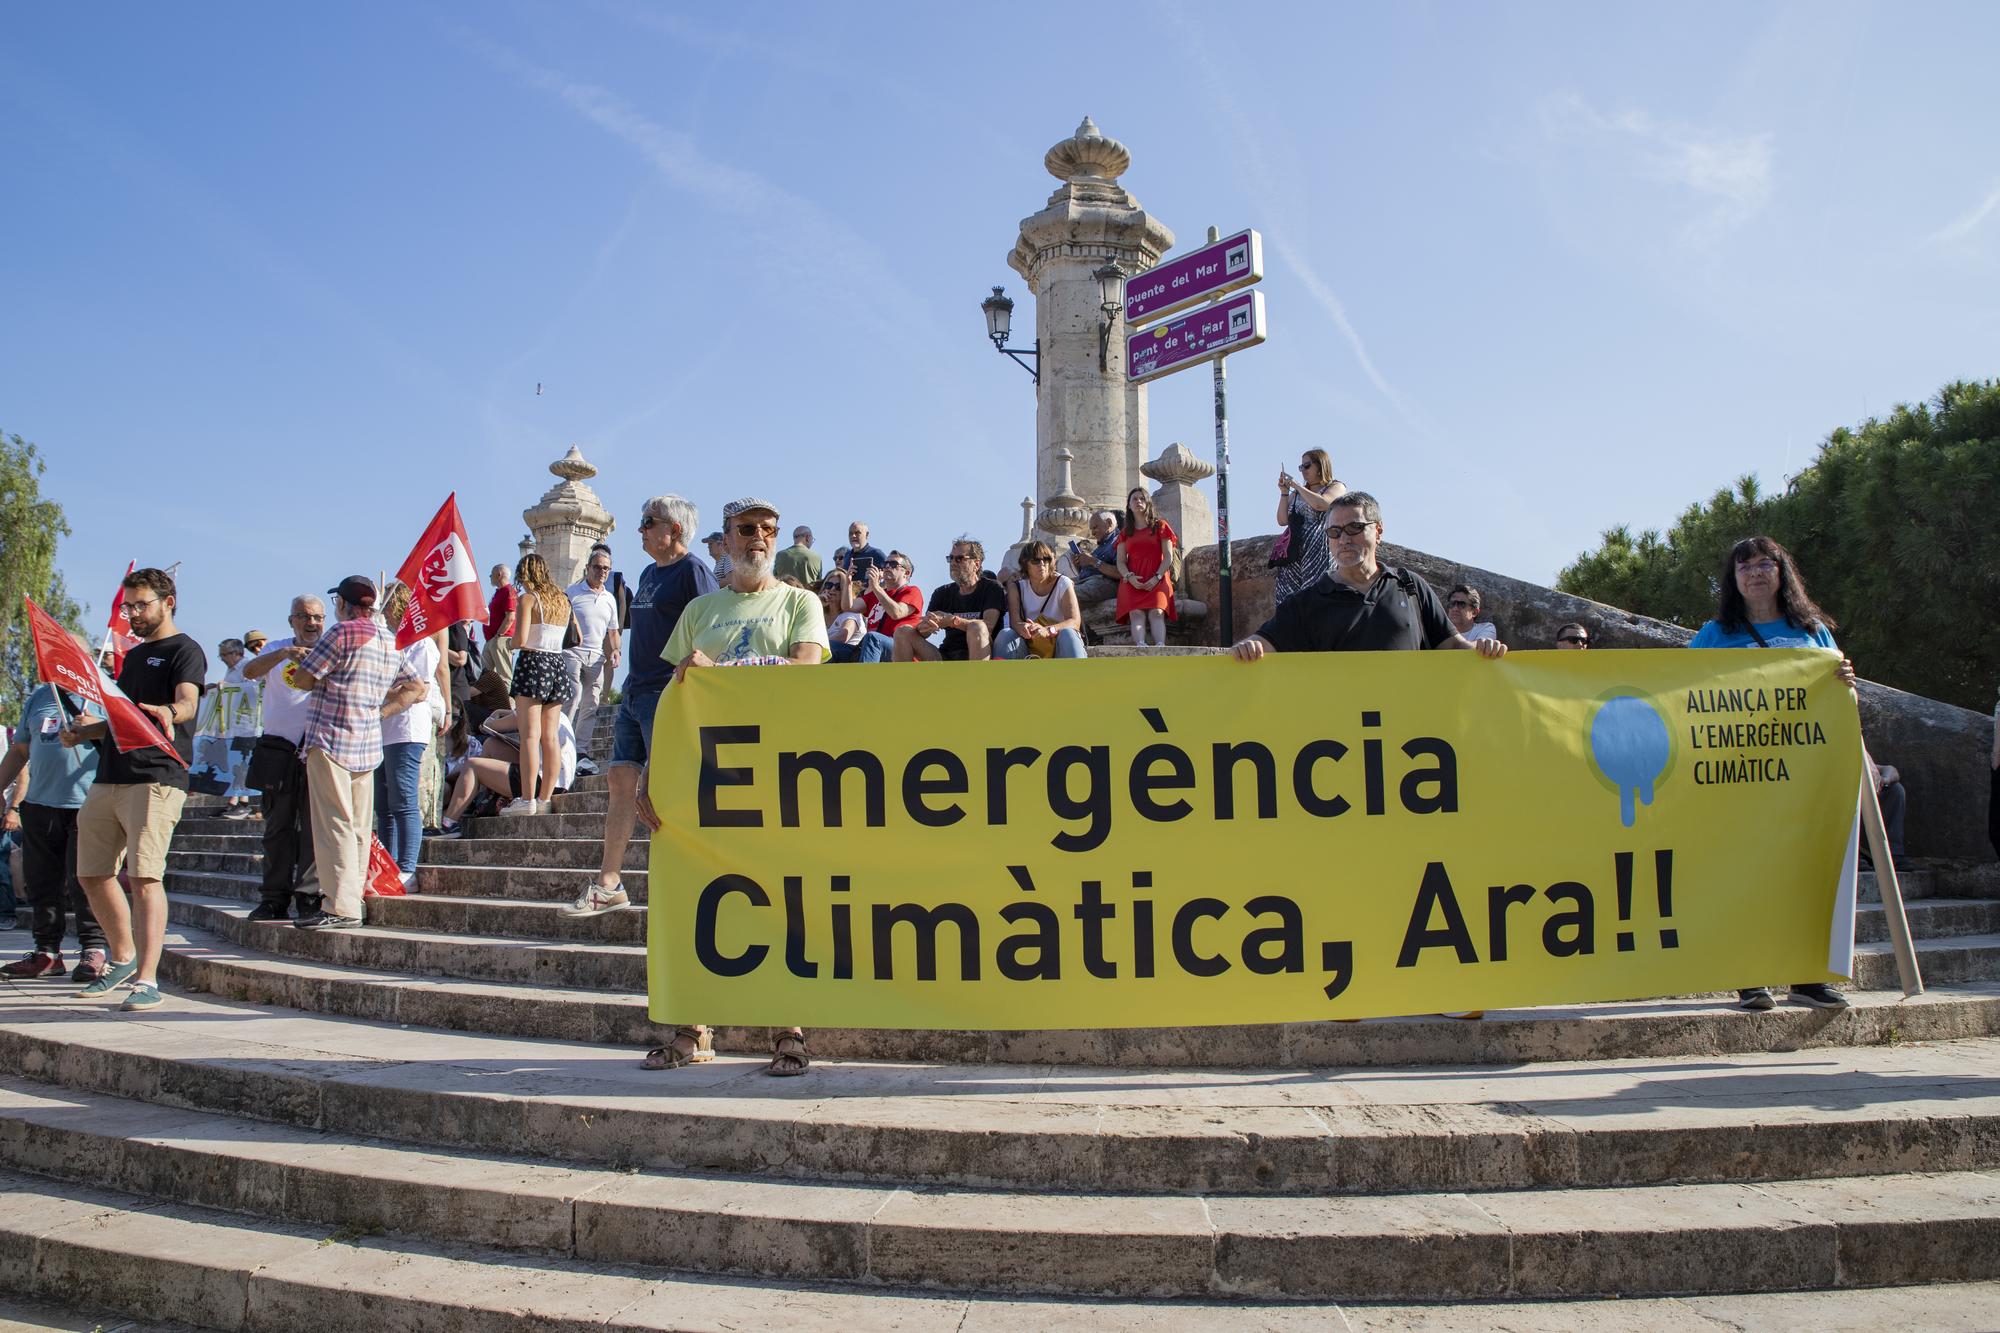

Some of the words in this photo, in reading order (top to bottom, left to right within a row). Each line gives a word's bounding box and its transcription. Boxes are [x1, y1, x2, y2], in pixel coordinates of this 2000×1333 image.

[1128, 284, 1165, 307] puente
[1171, 273, 1189, 288] del
[1196, 263, 1218, 279] Mar
[1133, 343, 1158, 362] pnt
[1165, 337, 1178, 349] de
[1184, 331, 1195, 342] l
[1687, 688, 1768, 718] ALIANÇA
[1774, 688, 1807, 711] PER
[1691, 717, 1827, 749] L'EMERGÈNCIA
[697, 707, 1459, 853] Emergència
[1694, 754, 1790, 785] CLIMÀTICA
[694, 865, 1353, 1001] Climàtica,
[1396, 848, 1680, 969] Ara!!
